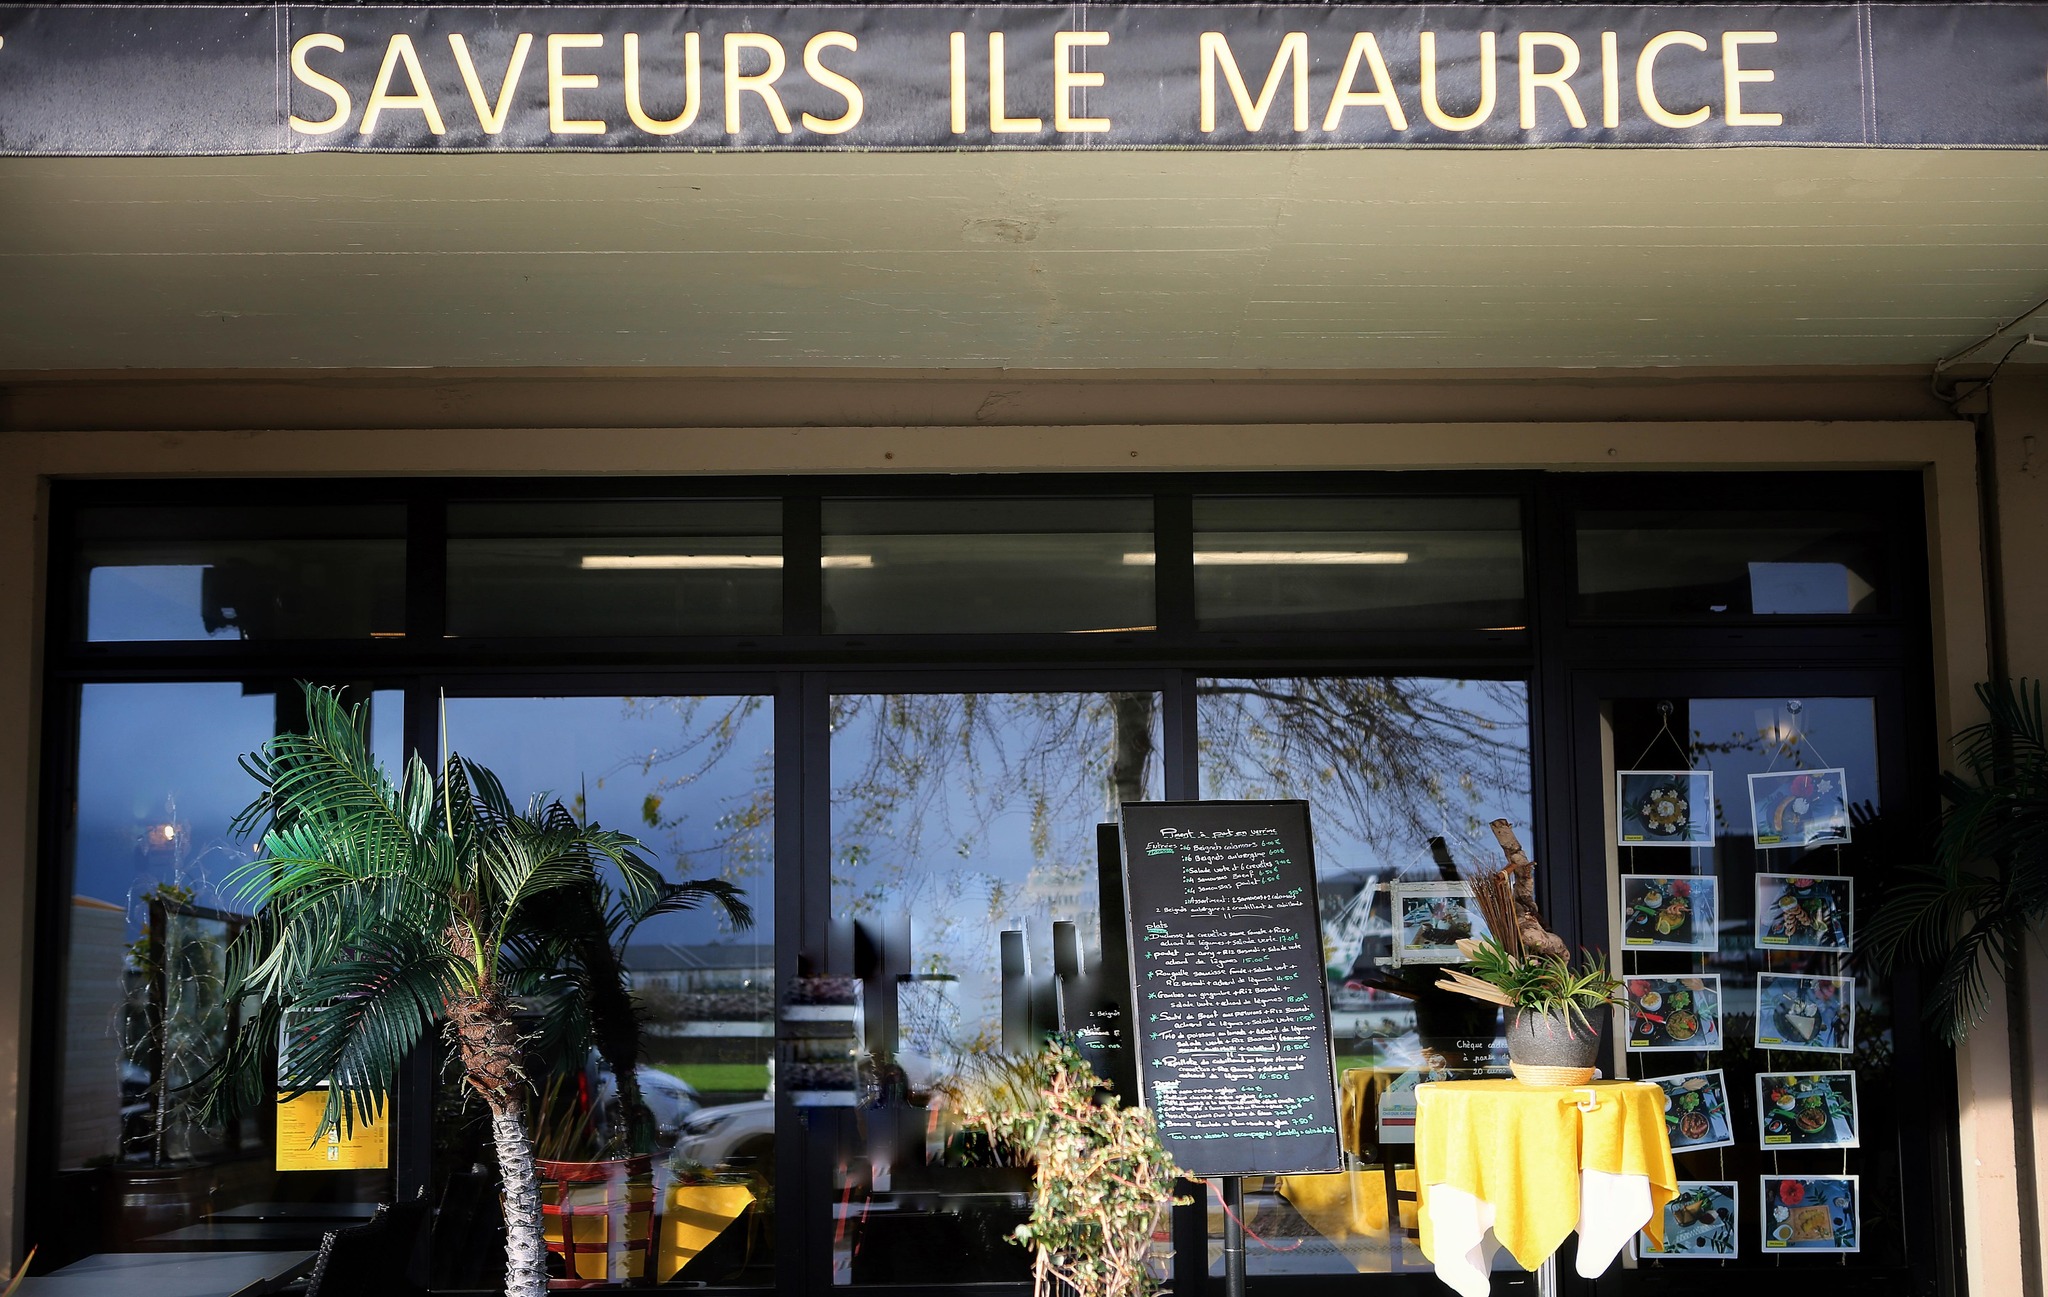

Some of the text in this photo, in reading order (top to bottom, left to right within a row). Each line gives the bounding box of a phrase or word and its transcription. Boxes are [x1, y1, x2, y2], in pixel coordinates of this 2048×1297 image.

[289, 31, 1783, 136] SAVEURS ILE MAURICE
[1250, 828, 1277, 836] verrine
[1193, 842, 1222, 853] Beignets
[1195, 853, 1224, 864] Beignets
[1227, 852, 1266, 861] aubergine
[1231, 863, 1239, 871] et
[1245, 859, 1273, 869] crevettes
[1197, 929, 1228, 937] crevettes
[1456, 1040, 1483, 1050] Chèque
[1463, 1053, 1468, 1061] à
